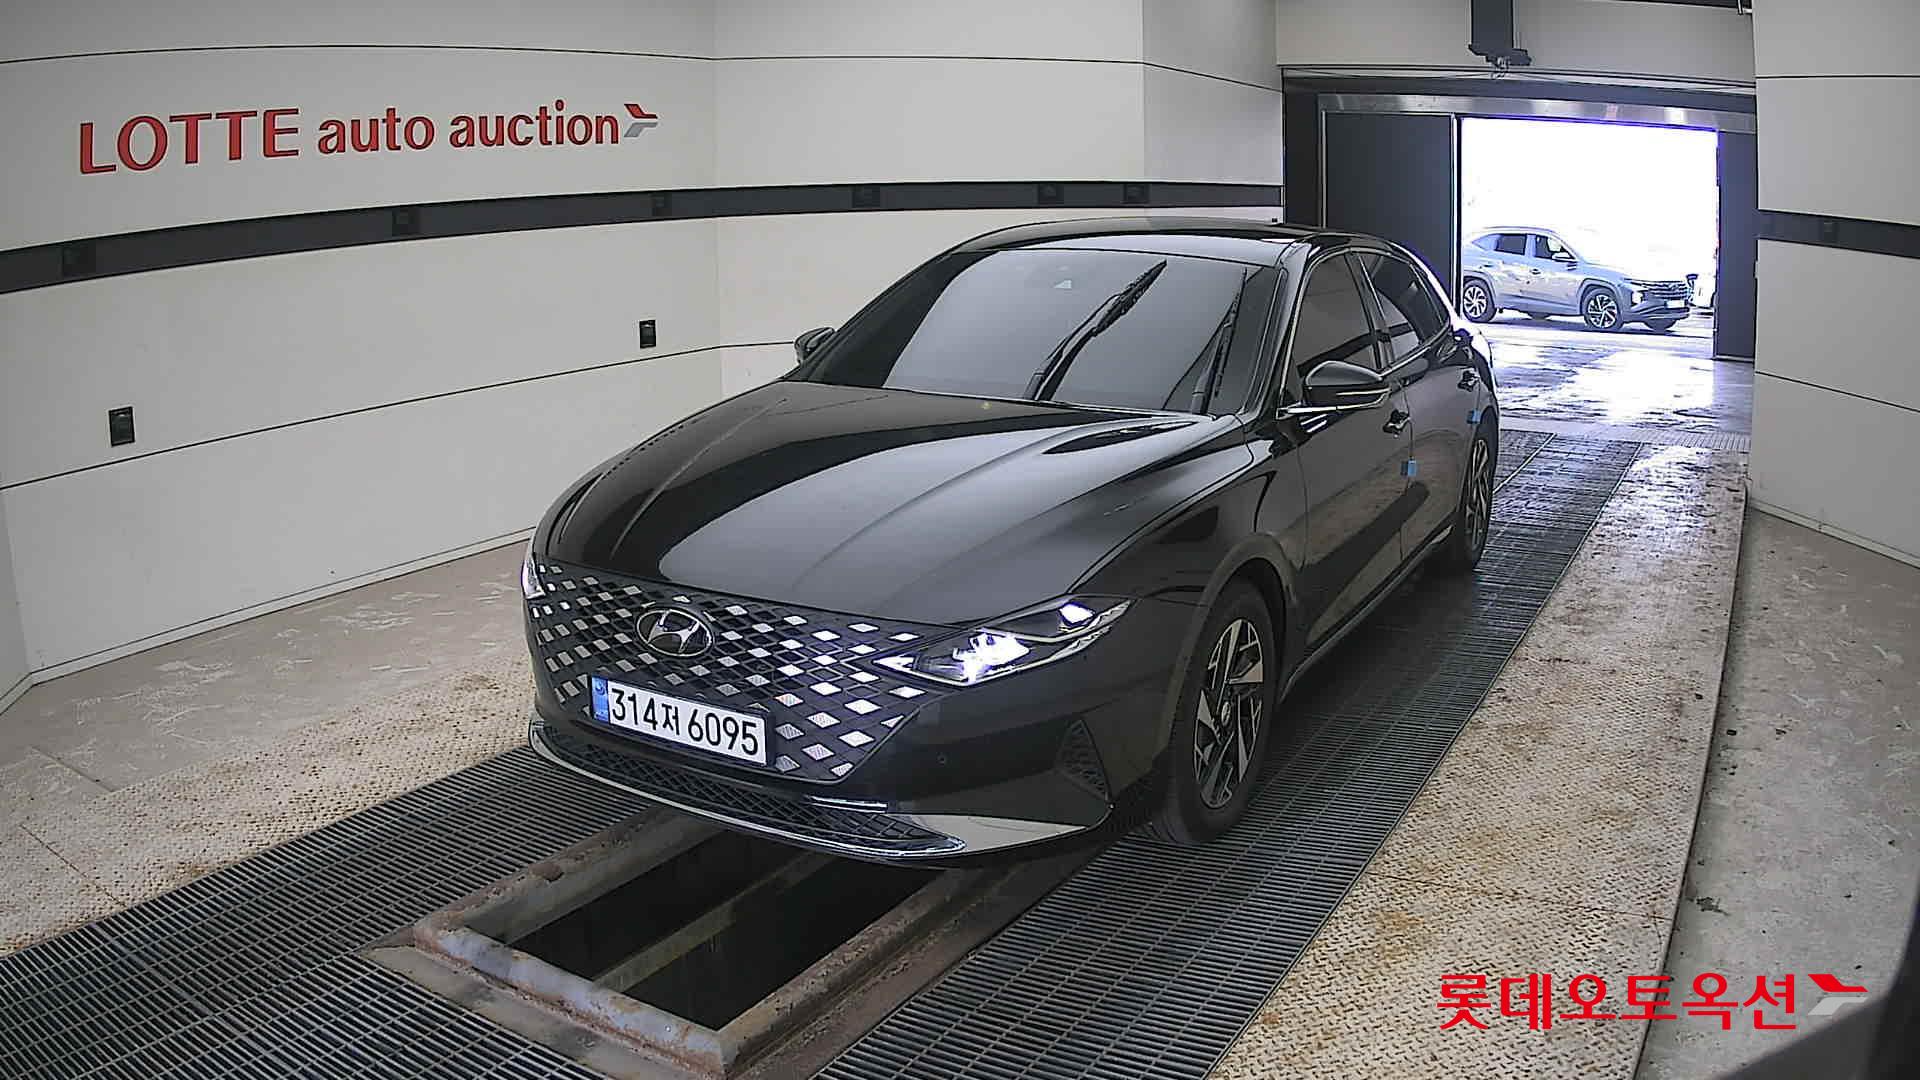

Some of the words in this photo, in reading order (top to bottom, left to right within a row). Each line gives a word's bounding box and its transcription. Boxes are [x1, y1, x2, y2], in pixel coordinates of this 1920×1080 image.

[79, 107, 299, 174] LOTTE
[317, 107, 434, 154] auto
[448, 99, 619, 148] auction
[611, 688, 680, 735] 314저
[688, 709, 758, 756] 6095
